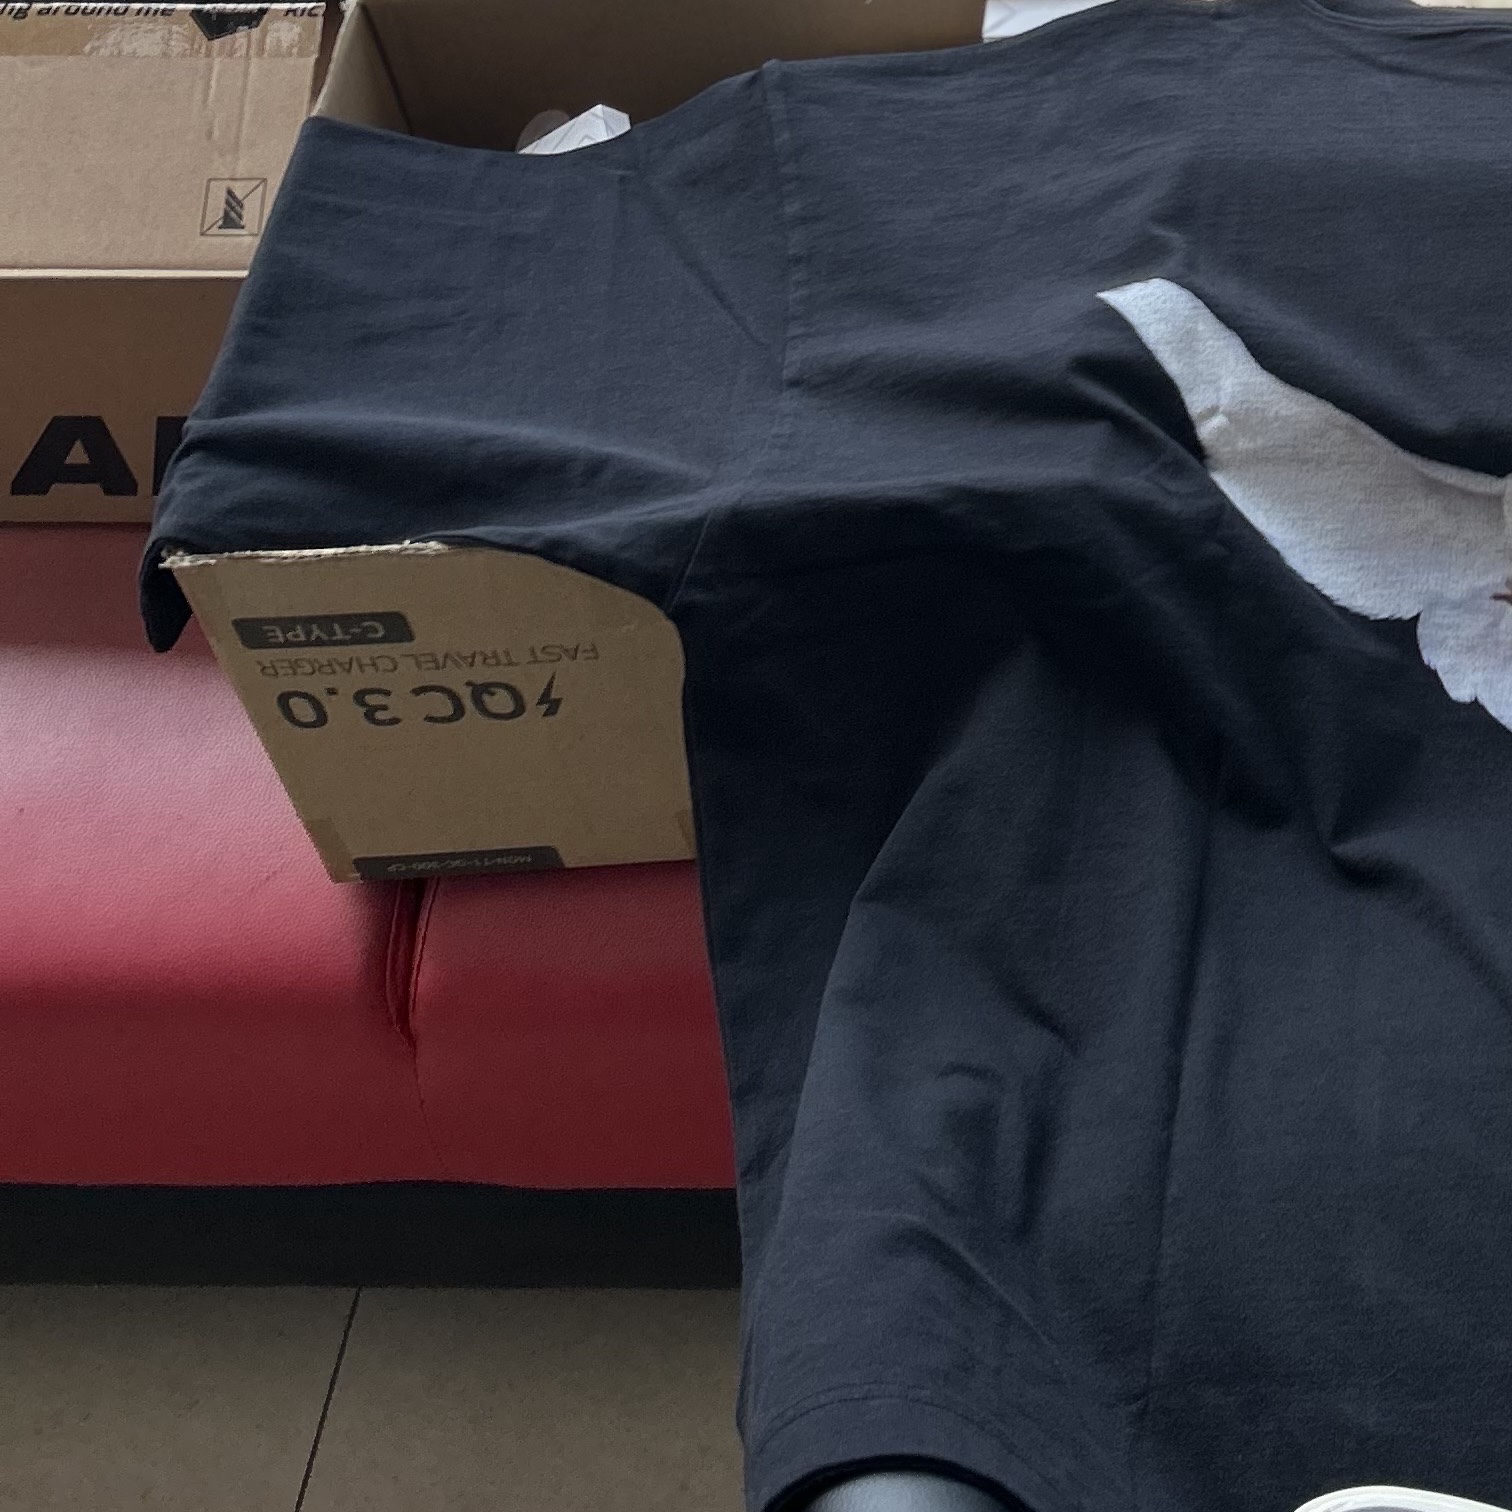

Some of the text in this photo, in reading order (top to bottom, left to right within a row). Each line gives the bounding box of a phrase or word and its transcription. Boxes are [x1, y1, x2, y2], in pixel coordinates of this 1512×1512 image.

[261, 620, 386, 644] C-TYPE
[255, 642, 600, 679] FAST TRAVEL CHARGER
[276, 680, 526, 729] QC 3.0
